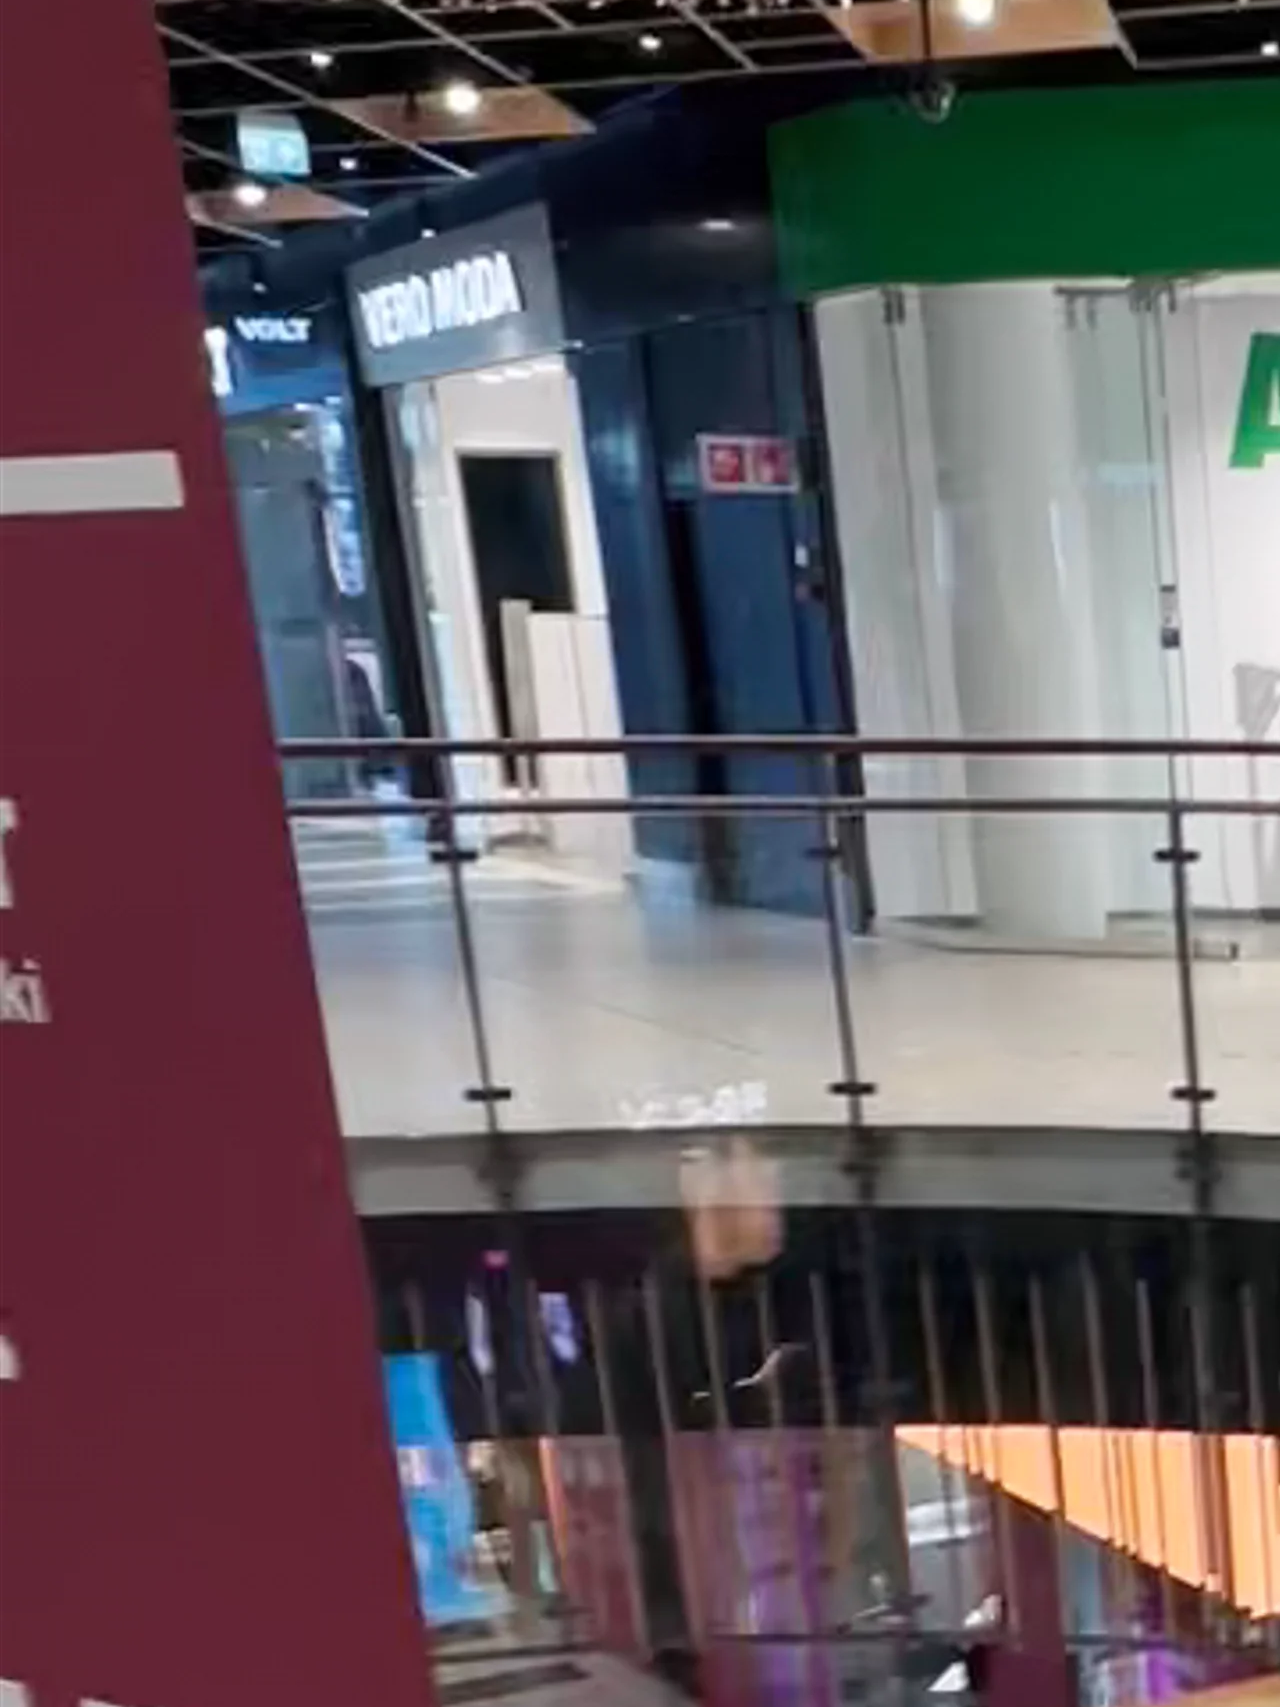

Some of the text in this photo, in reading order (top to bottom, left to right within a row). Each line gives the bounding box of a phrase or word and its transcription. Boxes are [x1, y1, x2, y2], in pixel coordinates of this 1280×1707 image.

[233, 316, 312, 342] VOLT
[357, 250, 524, 349] VERO MODA
